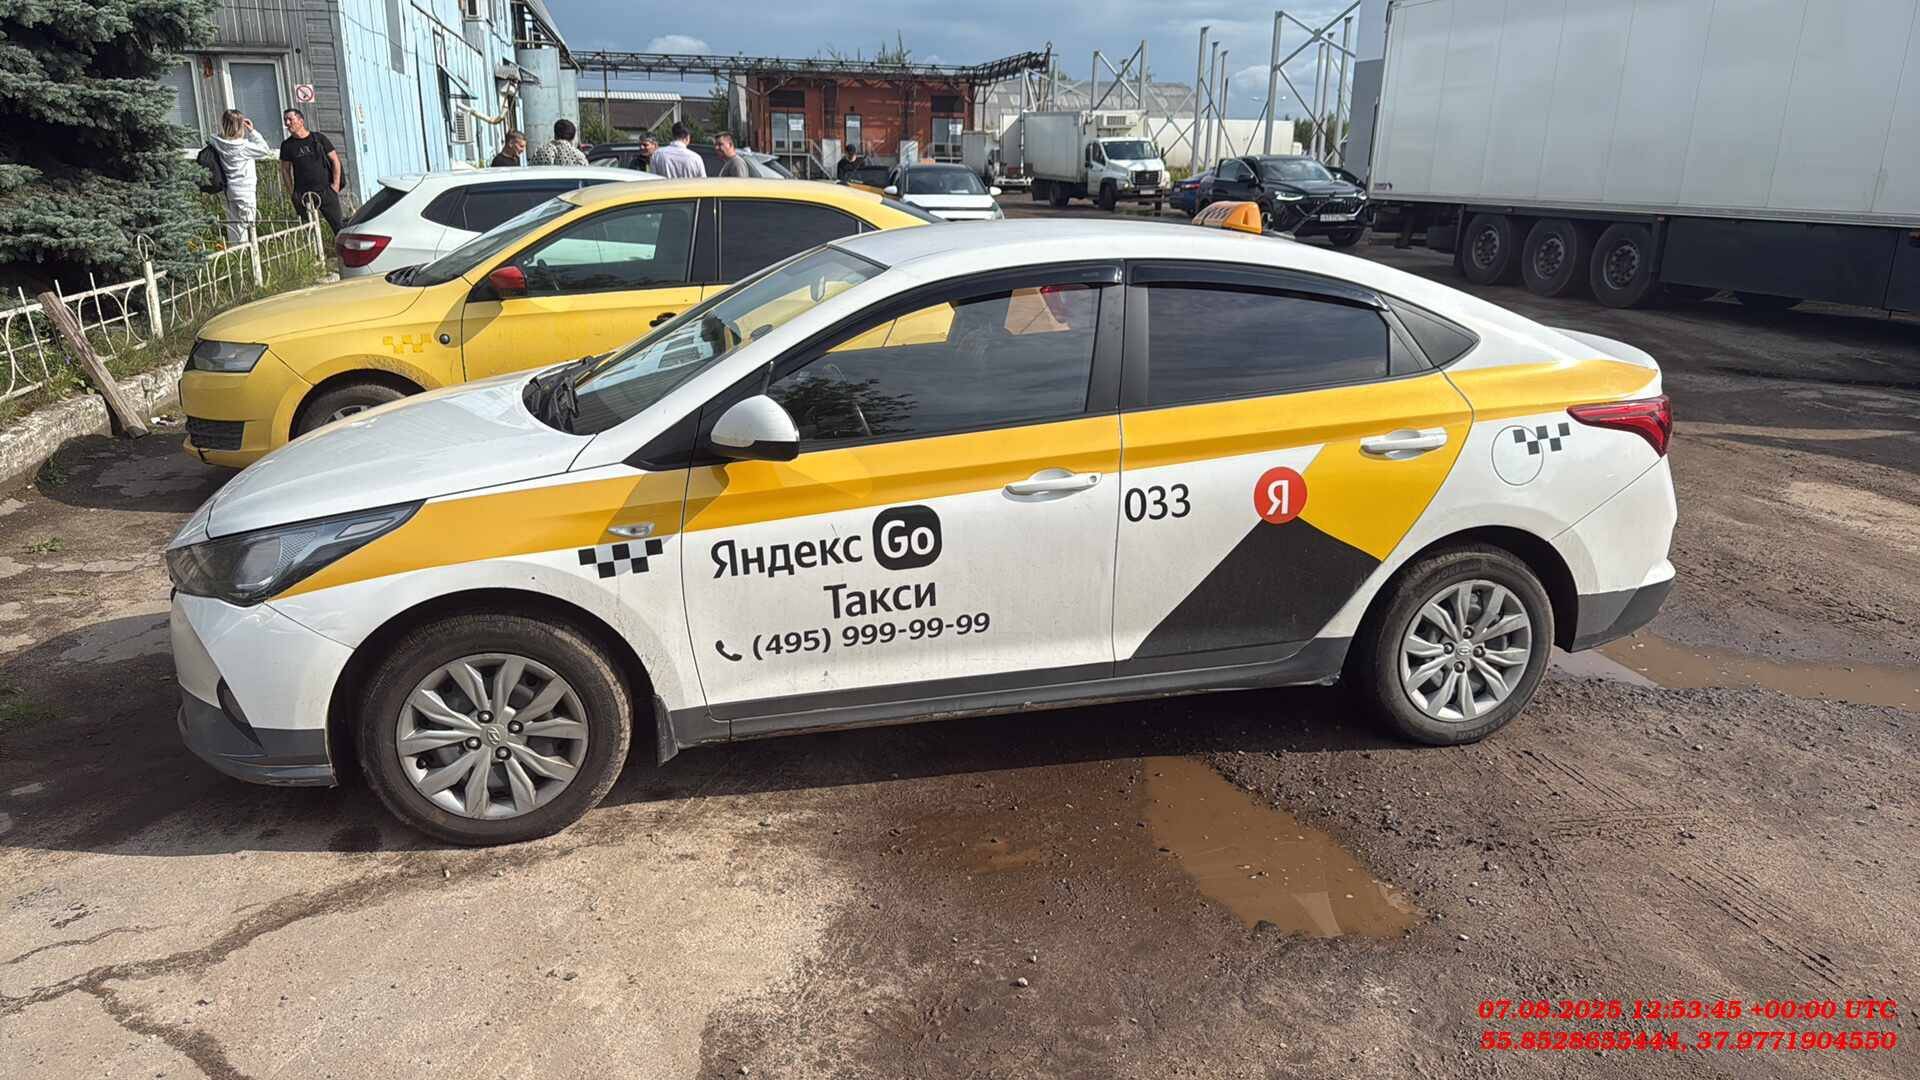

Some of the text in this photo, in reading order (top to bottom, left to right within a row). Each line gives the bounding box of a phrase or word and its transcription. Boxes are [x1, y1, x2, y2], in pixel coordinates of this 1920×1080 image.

[1123, 483, 1192, 522] 033
[1265, 478, 1290, 516] Я
[711, 519, 936, 579] Яндекс Go
[823, 580, 938, 620] Такси
[752, 611, 991, 661] (495) 999-99-99
